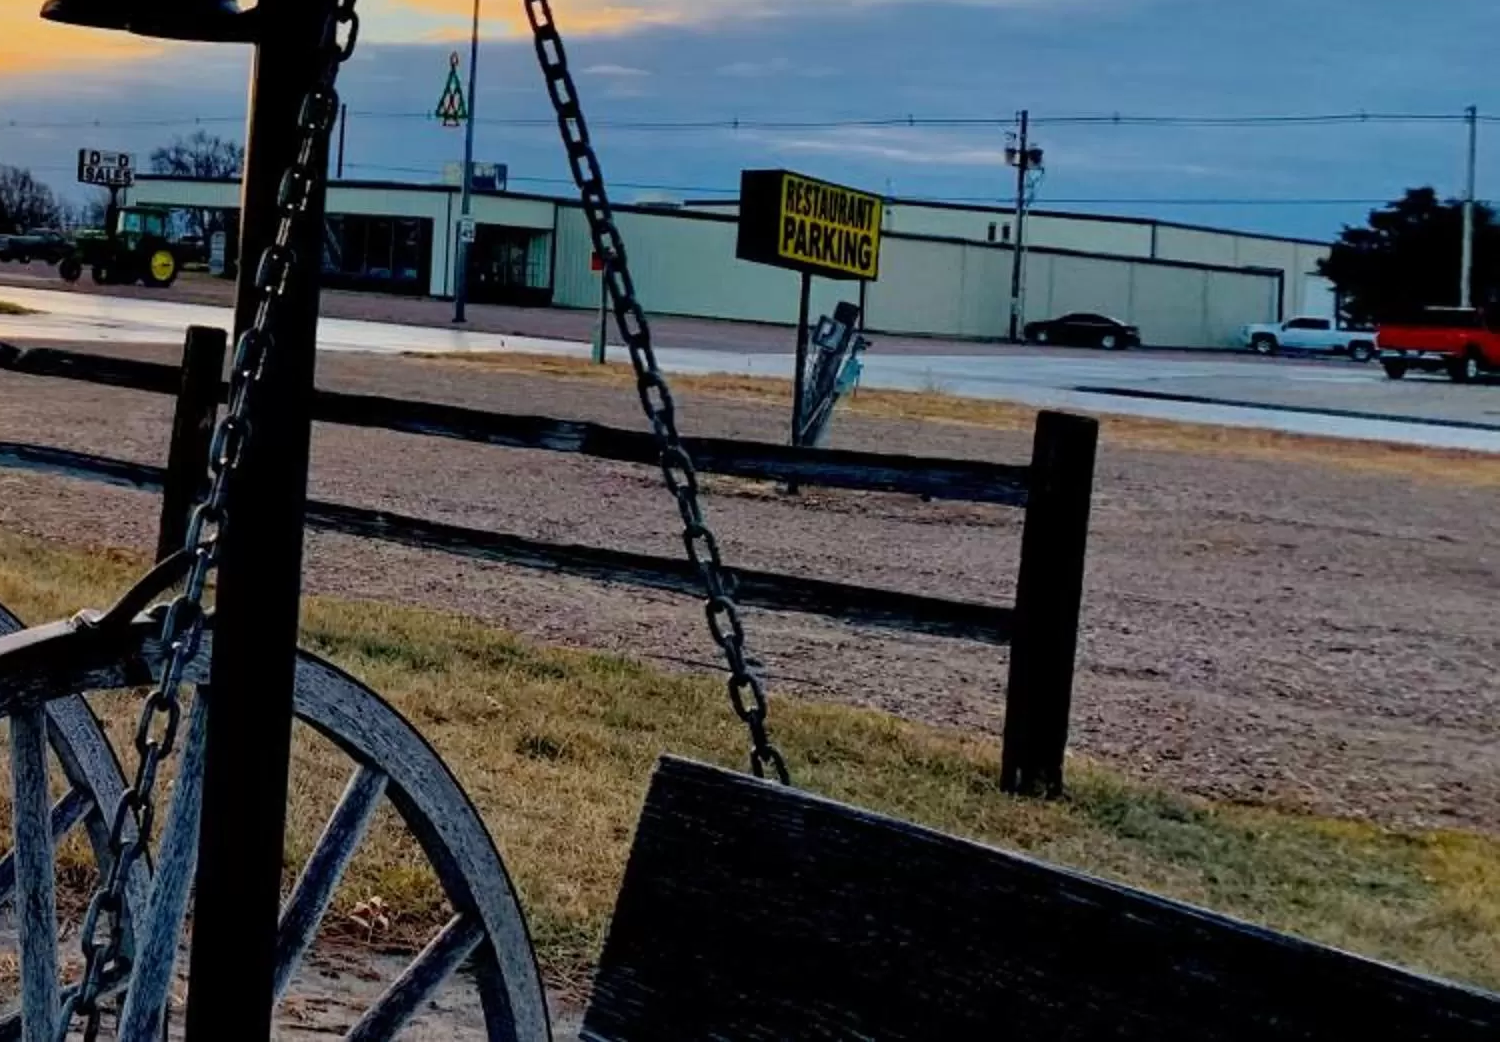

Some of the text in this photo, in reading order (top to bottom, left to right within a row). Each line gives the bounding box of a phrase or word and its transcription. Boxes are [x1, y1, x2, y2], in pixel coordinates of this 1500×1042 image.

[86, 166, 132, 184] SALES
[786, 180, 876, 231] RESTAURANT
[783, 216, 873, 271] PARKING
